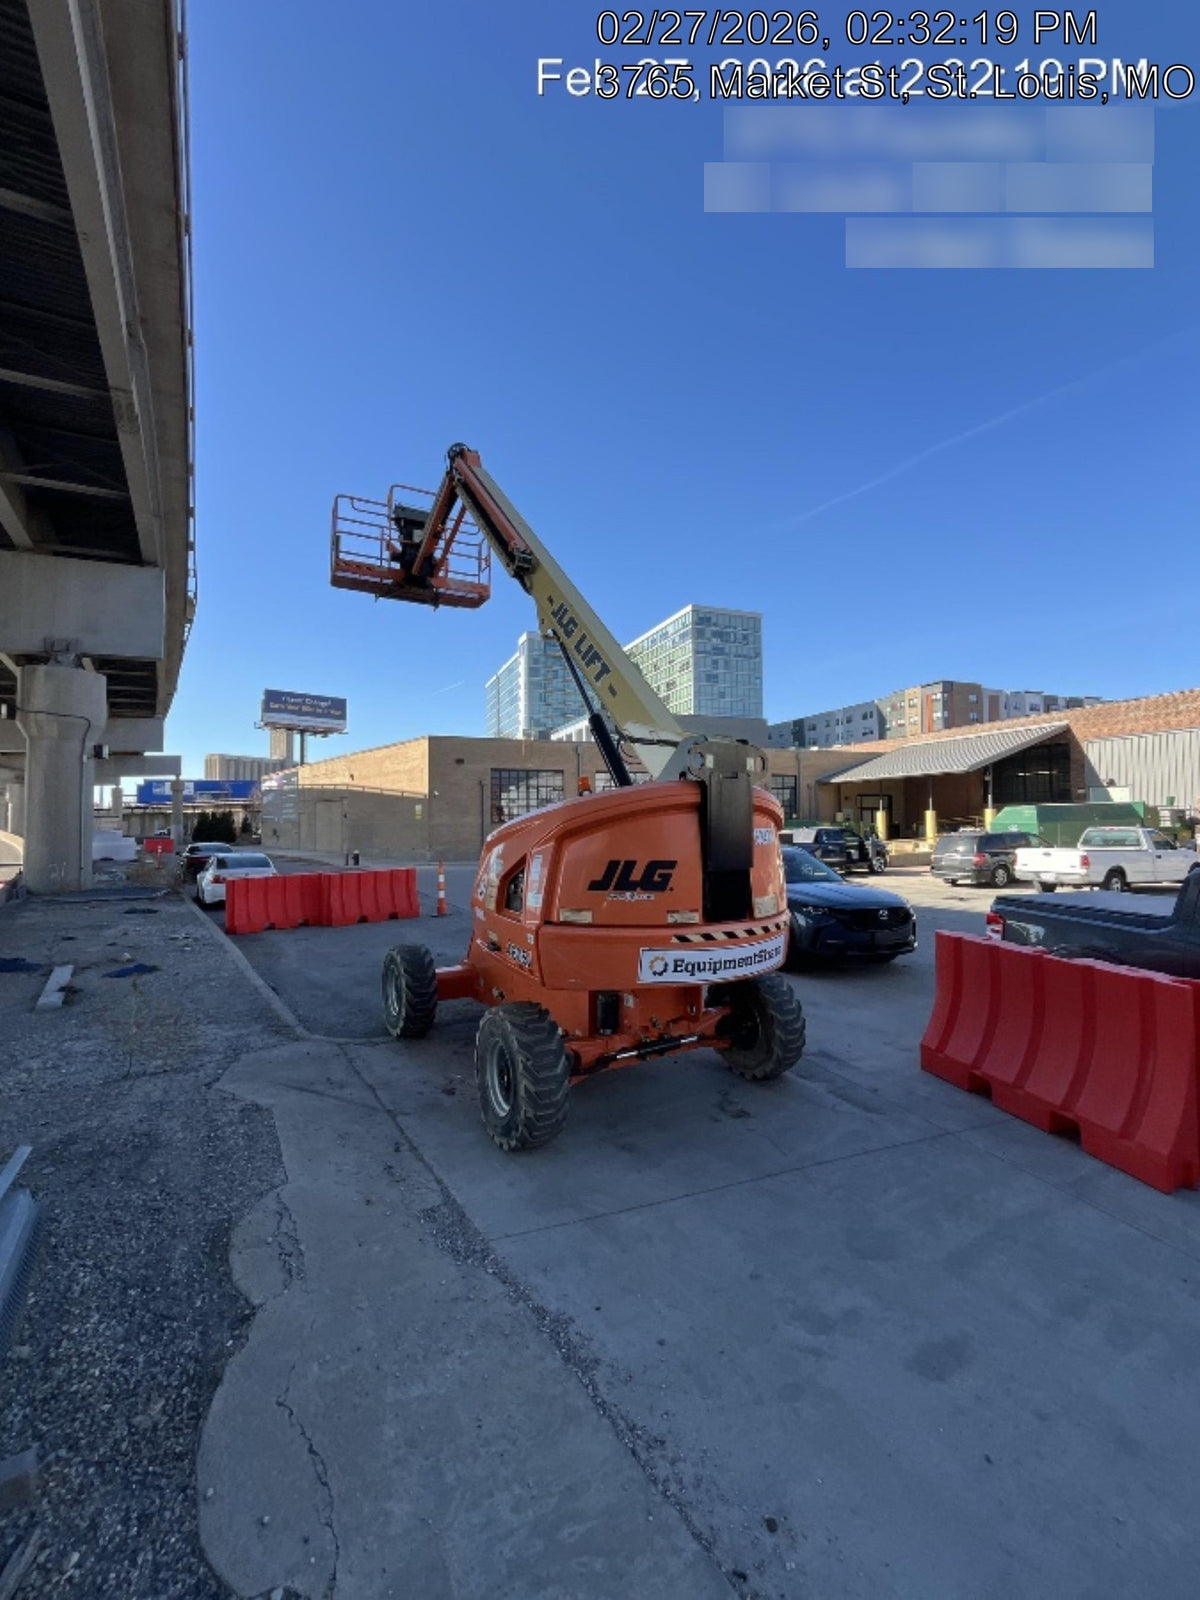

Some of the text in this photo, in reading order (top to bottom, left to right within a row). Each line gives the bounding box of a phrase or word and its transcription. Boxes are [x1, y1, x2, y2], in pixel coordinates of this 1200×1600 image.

[551, 602, 612, 682] JLG LIFT
[587, 860, 678, 891] JLG
[671, 945, 782, 976] EquipmentShar
